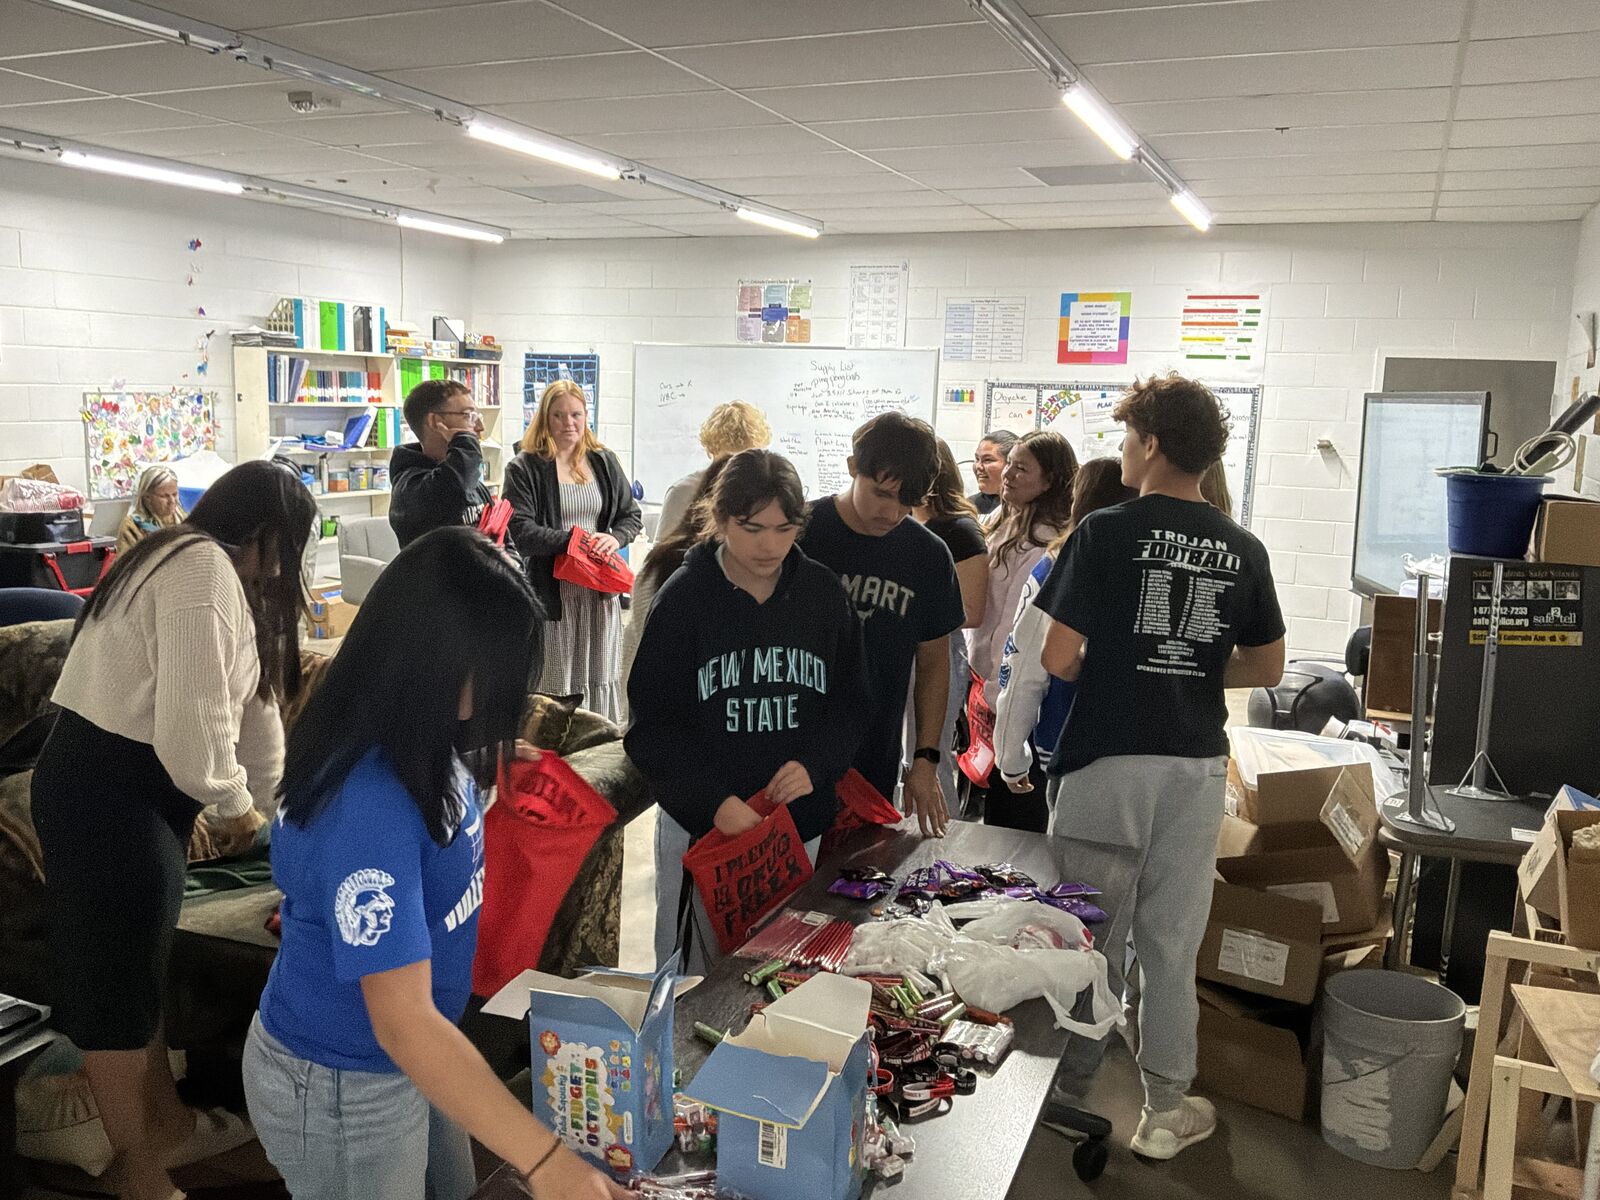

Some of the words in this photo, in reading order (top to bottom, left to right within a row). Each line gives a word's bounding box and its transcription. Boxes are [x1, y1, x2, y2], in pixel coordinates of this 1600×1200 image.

[1009, 410, 1023, 419] can
[1042, 392, 1082, 426] SEMINAR
[1141, 541, 1240, 570] FOOTBALL
[1151, 529, 1227, 551] TROJAN
[698, 649, 746, 702] NEW
[753, 646, 827, 695] MEXICO
[726, 693, 799, 732] STATE
[569, 1062, 584, 1131] FIDGET
[584, 1057, 600, 1147] OCTOPUS
